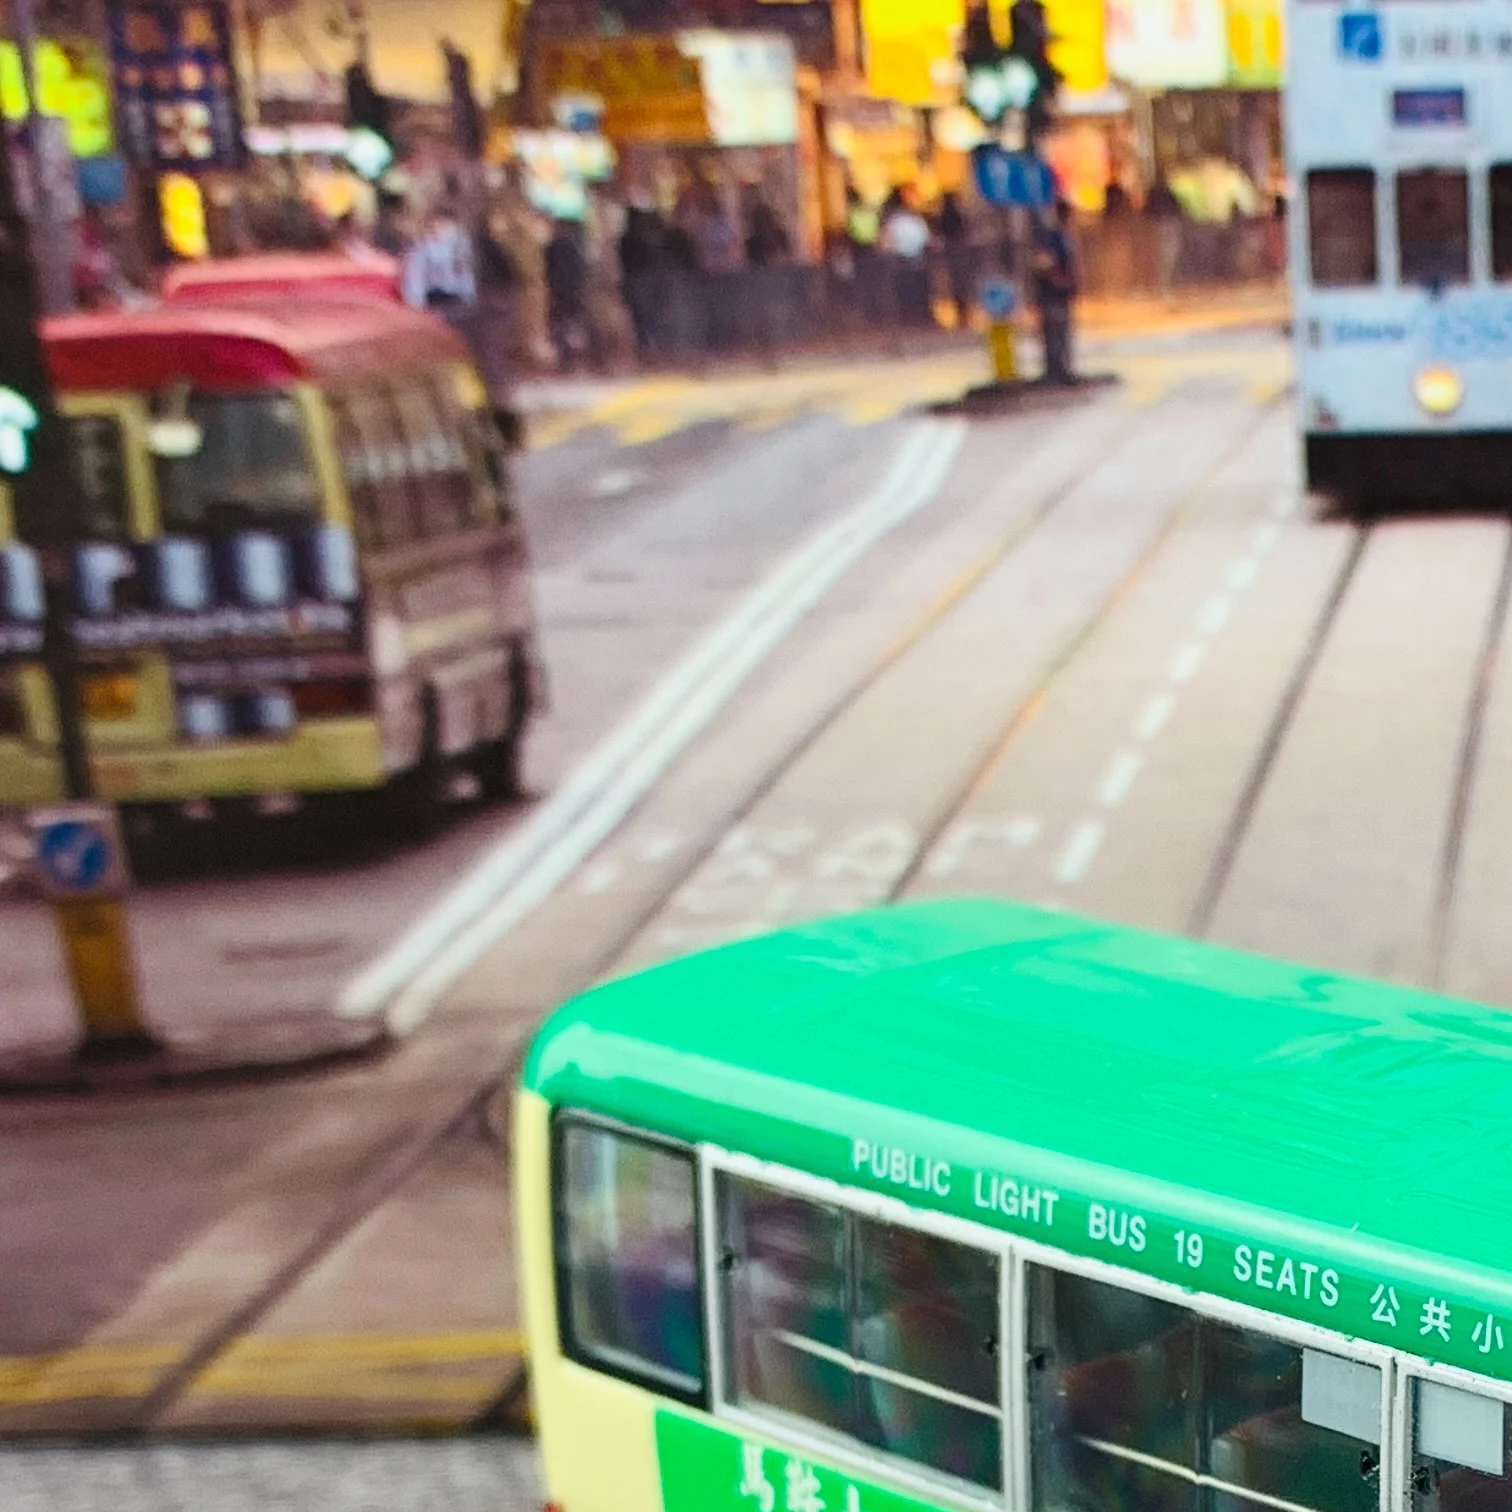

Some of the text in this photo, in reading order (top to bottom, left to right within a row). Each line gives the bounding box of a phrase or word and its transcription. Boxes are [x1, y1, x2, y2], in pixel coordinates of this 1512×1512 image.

[852, 1138, 1340, 1307] PUBLIC LIGHT BUS 19 SEATS
